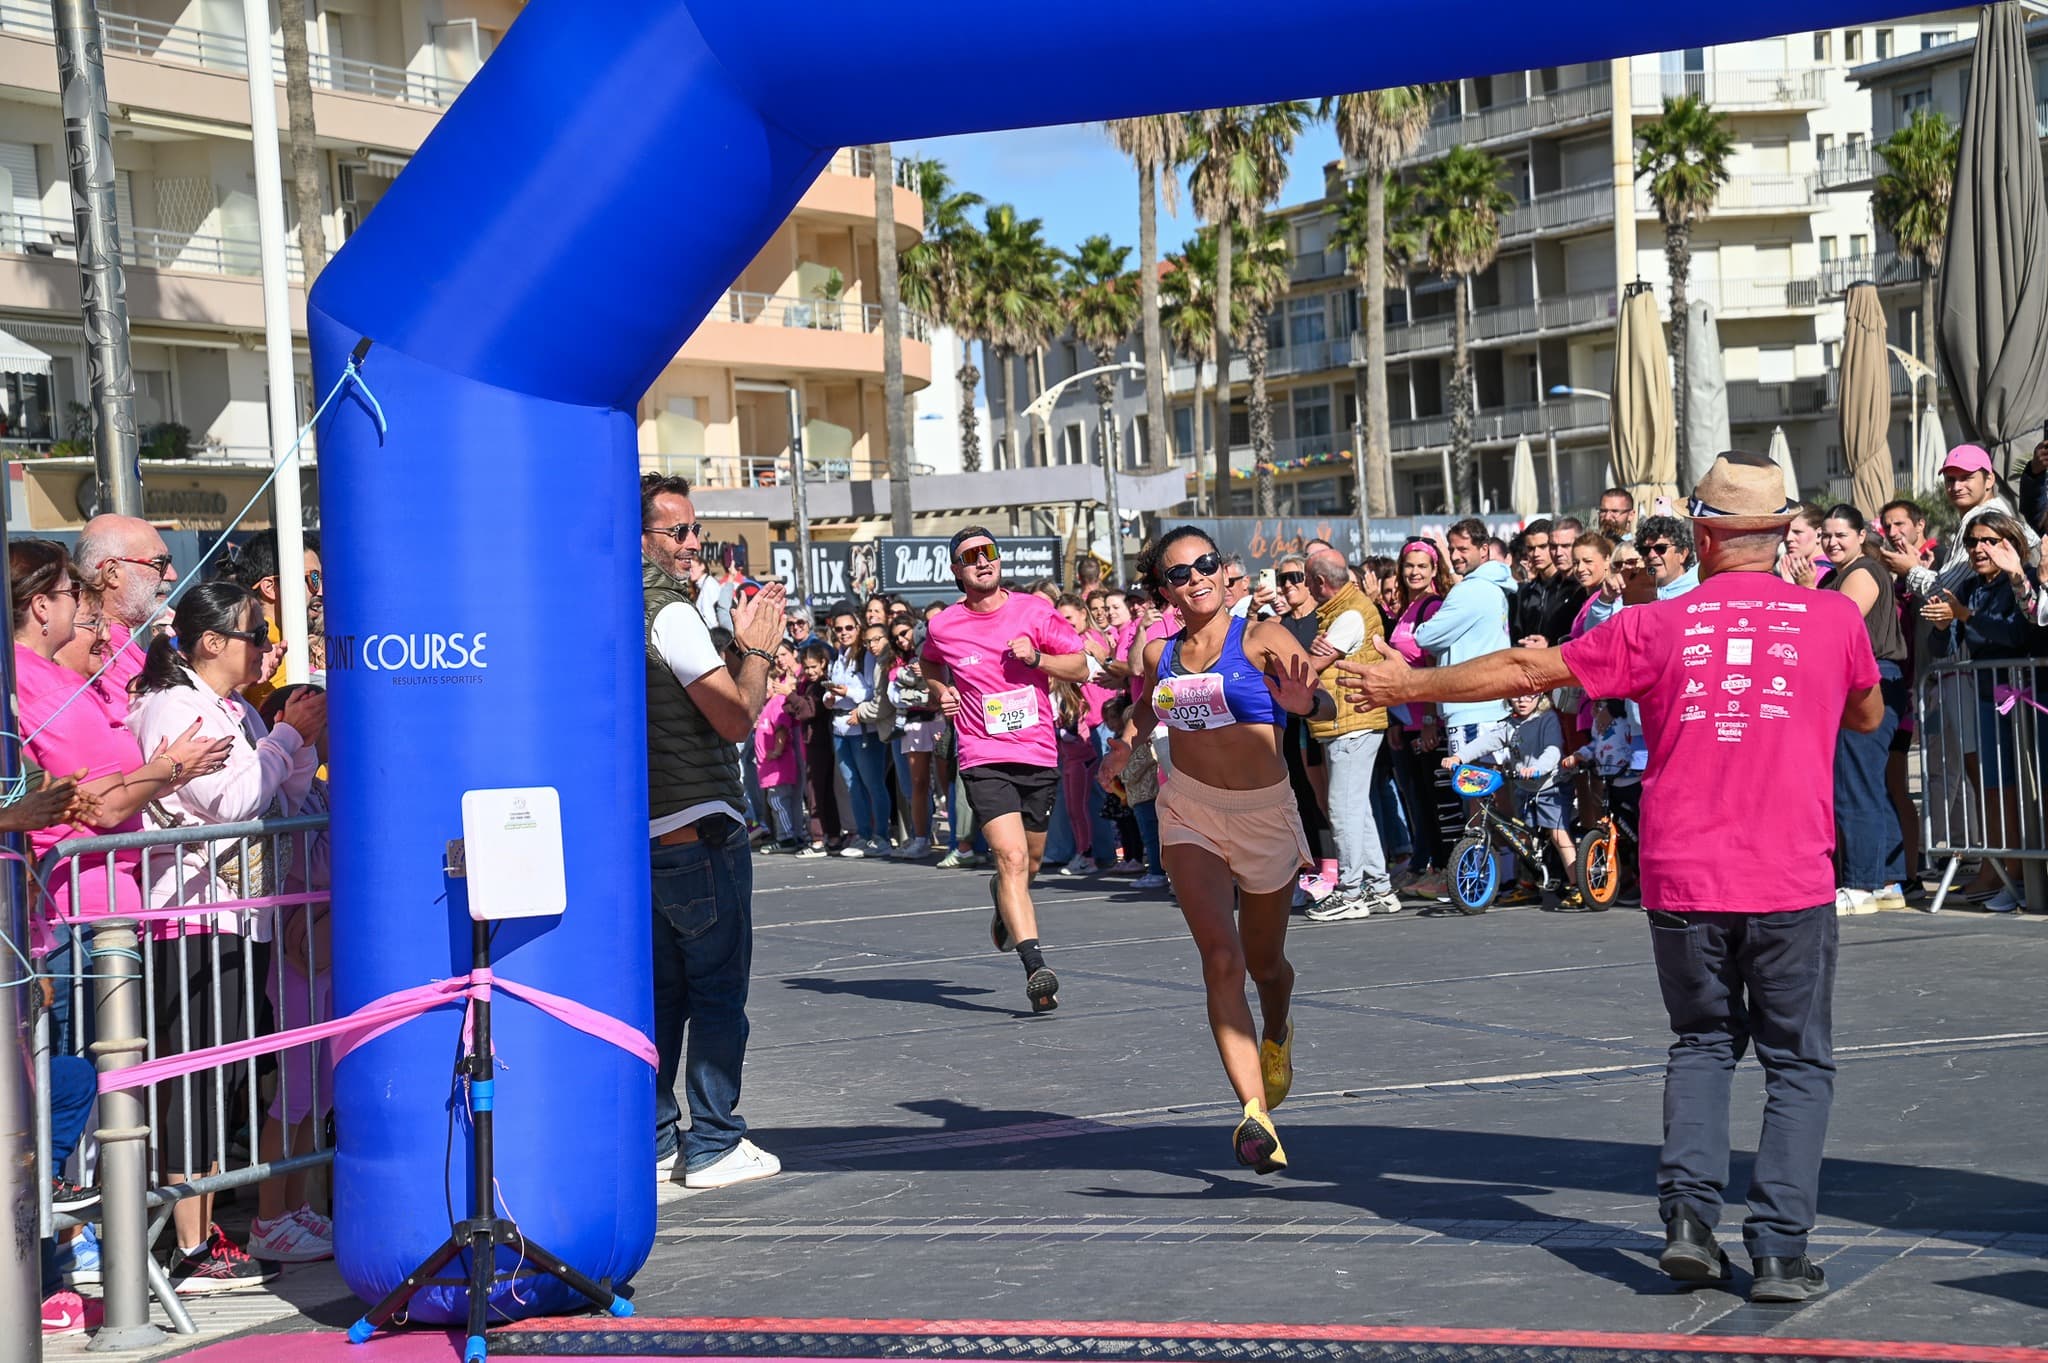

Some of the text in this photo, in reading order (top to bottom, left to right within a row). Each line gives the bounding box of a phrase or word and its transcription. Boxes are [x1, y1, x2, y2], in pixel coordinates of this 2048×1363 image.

[774, 548, 846, 595] Blix
[895, 545, 933, 584] Bulle
[325, 632, 488, 671] OINT COURSE
[1683, 643, 1713, 656] ATOL
[392, 675, 483, 685] RESULTATS SPORTIFS
[1182, 687, 1209, 699] Rose
[1000, 709, 1025, 722] 2195
[1170, 704, 1210, 720] 3093
